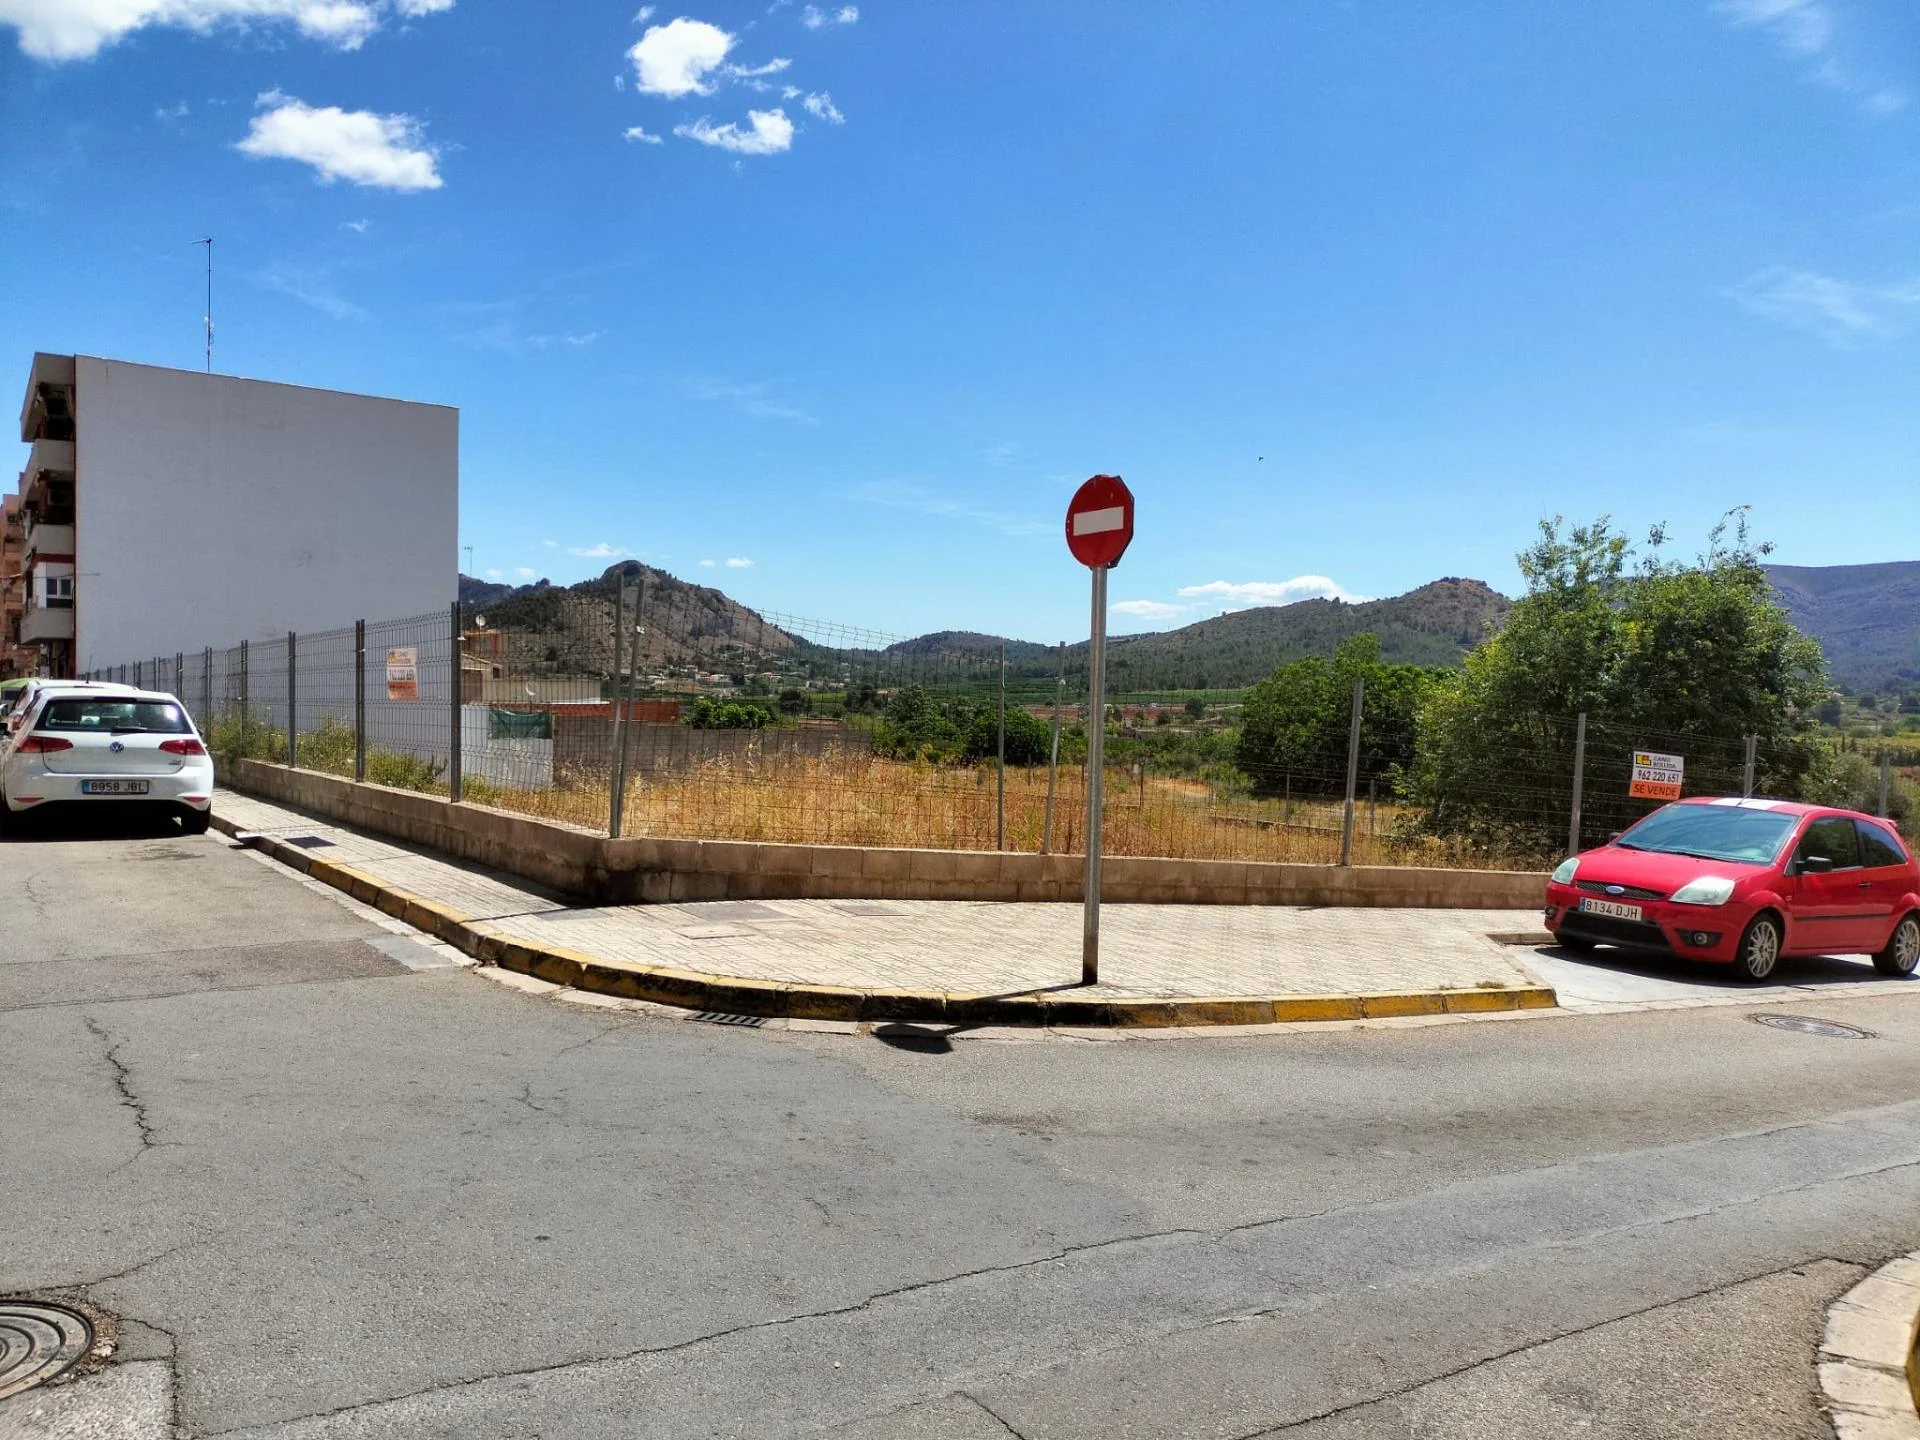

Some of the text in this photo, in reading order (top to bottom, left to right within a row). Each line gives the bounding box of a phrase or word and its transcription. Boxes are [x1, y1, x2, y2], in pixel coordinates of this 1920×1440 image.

[1637, 770, 1680, 783] 962 220 651
[124, 782, 145, 792] JBL
[1633, 783, 1677, 797] SE VENDE
[1585, 900, 1638, 919] 8134 DJH
